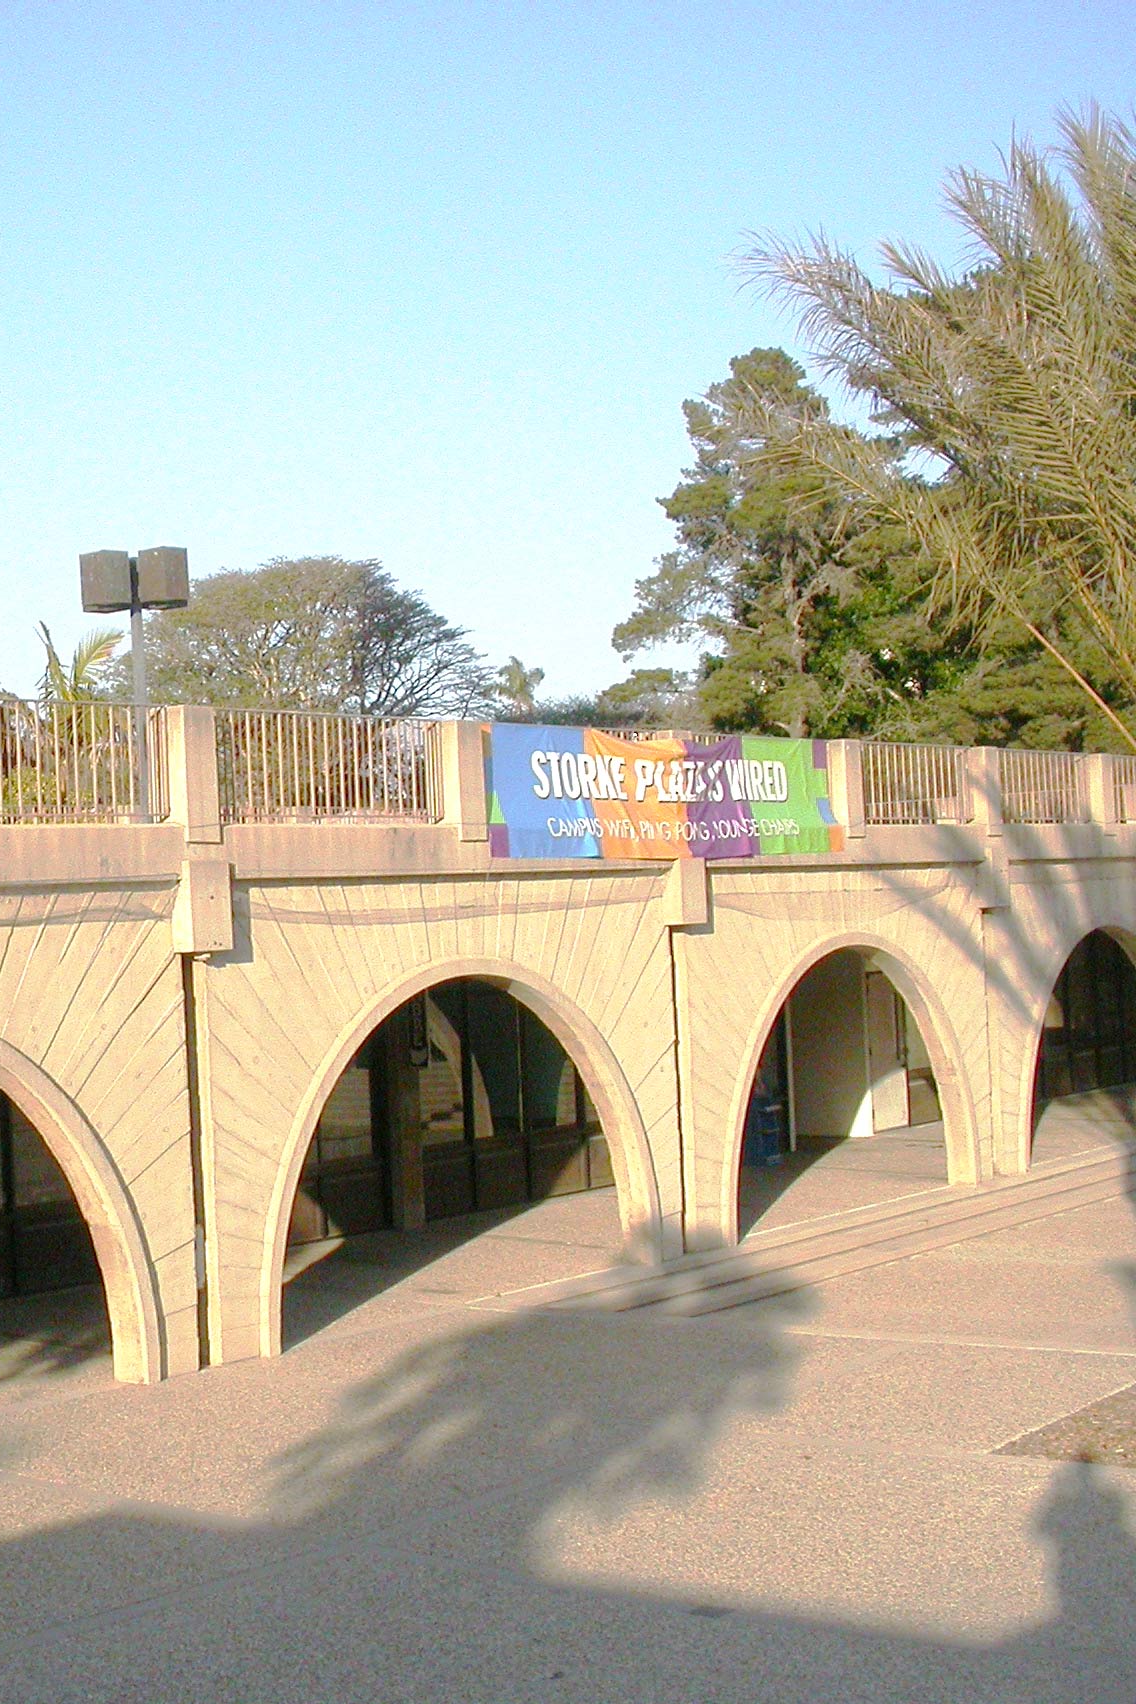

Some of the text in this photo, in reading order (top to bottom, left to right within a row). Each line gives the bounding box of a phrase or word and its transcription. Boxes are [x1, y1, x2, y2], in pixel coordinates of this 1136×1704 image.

[531, 750, 628, 801] STORKE
[725, 758, 788, 803] WIRED
[547, 817, 604, 838] CAMPUS
